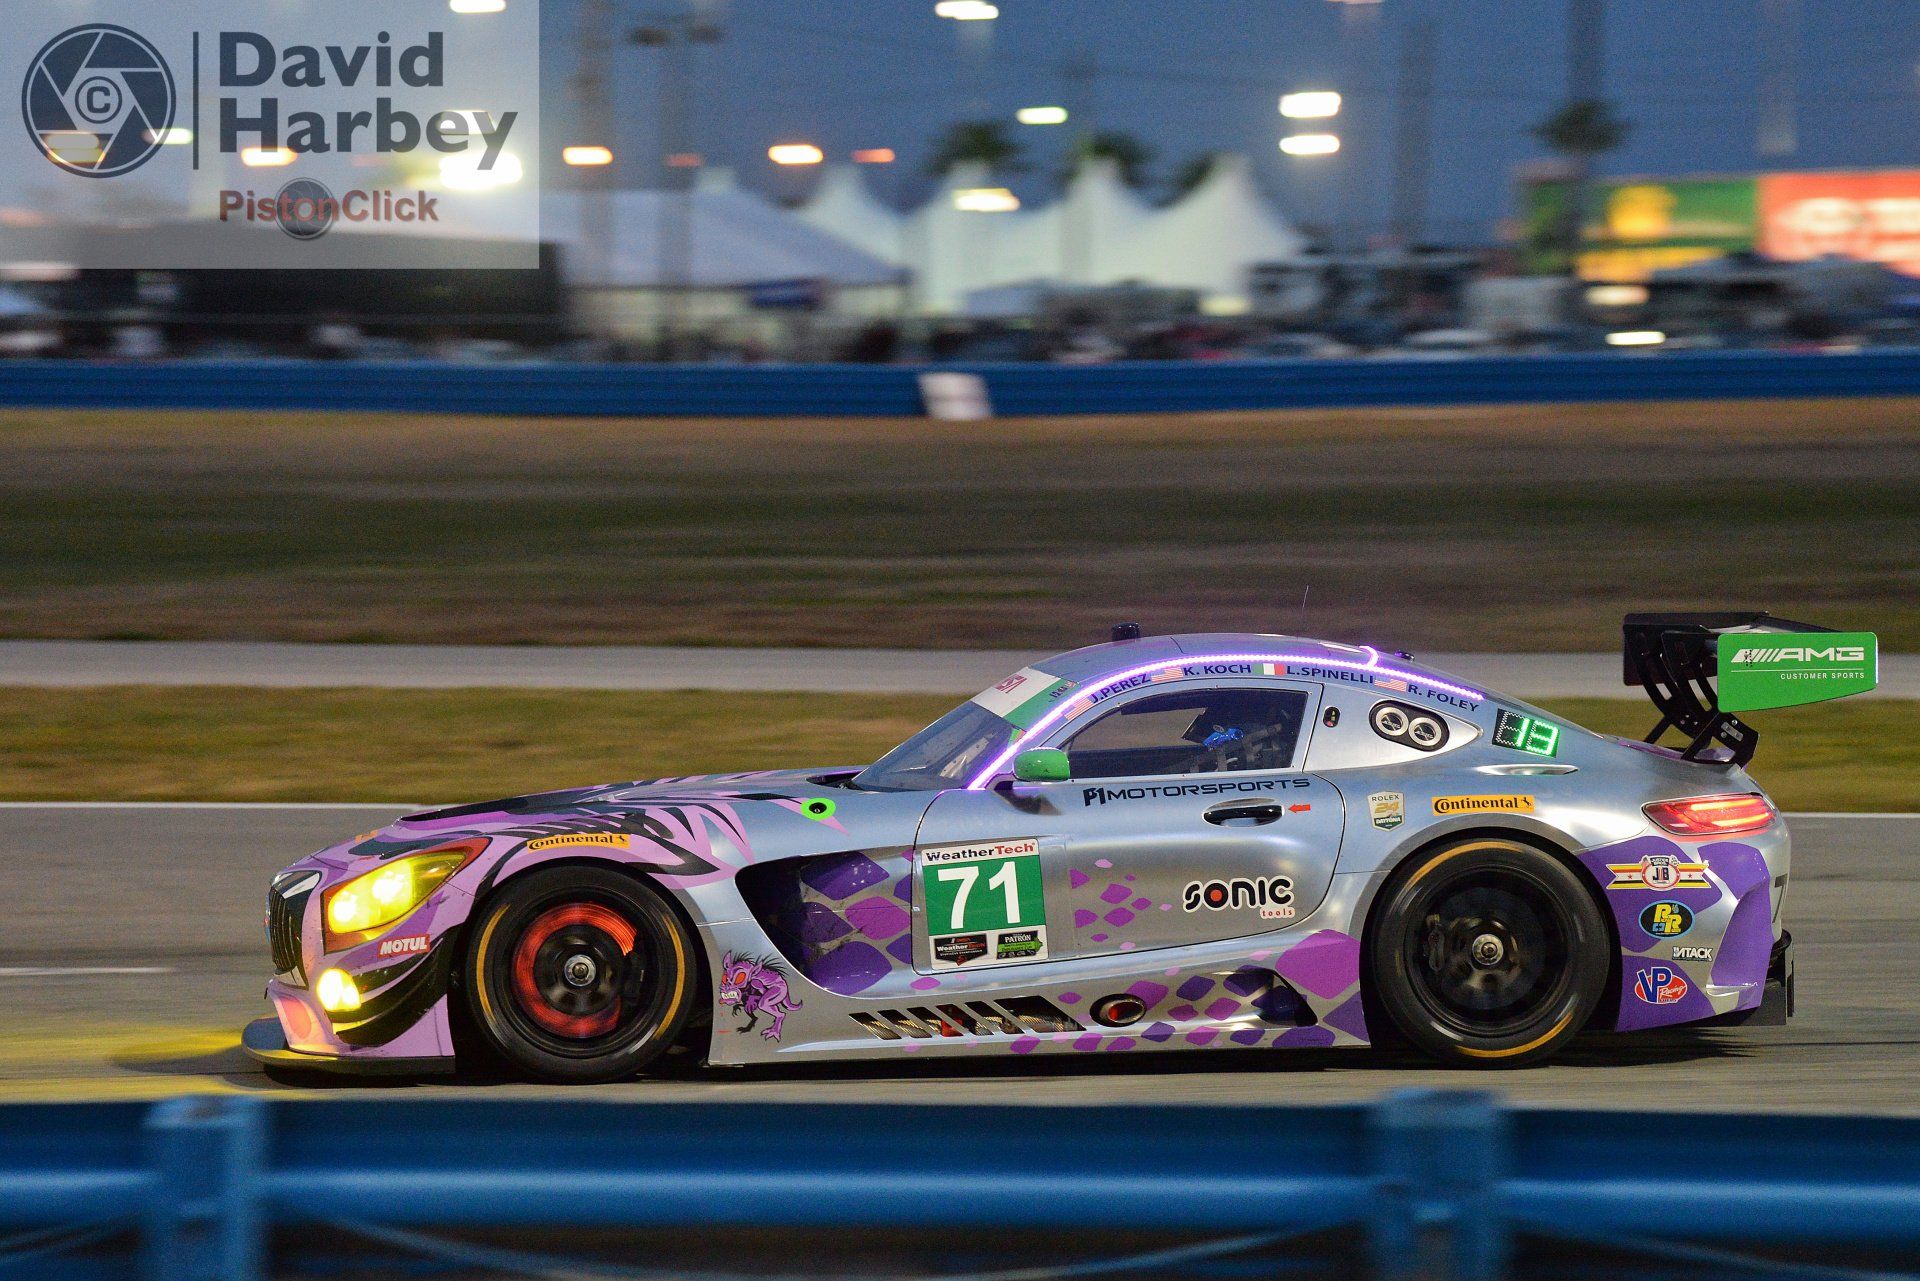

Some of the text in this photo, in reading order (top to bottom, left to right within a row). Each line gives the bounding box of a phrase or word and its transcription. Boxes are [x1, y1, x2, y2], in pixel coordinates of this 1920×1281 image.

[1775, 647, 1865, 662] AMG
[1182, 663, 1252, 676] K. KOCH
[1286, 666, 1374, 684] L.SPINELLI
[1780, 672, 1828, 680] CUSTOMER
[1089, 673, 1151, 704] J.PEREZ
[1408, 684, 1480, 712] R. FOLEY
[1433, 797, 1519, 814] Continental
[528, 835, 613, 850] Continental
[925, 843, 1034, 862] WeatherTech
[937, 861, 1021, 930] 71
[1262, 909, 1293, 917] tools
[380, 936, 428, 955] MOTUL
[1637, 967, 1673, 1003] VP
[1659, 983, 1687, 1000] Racing
